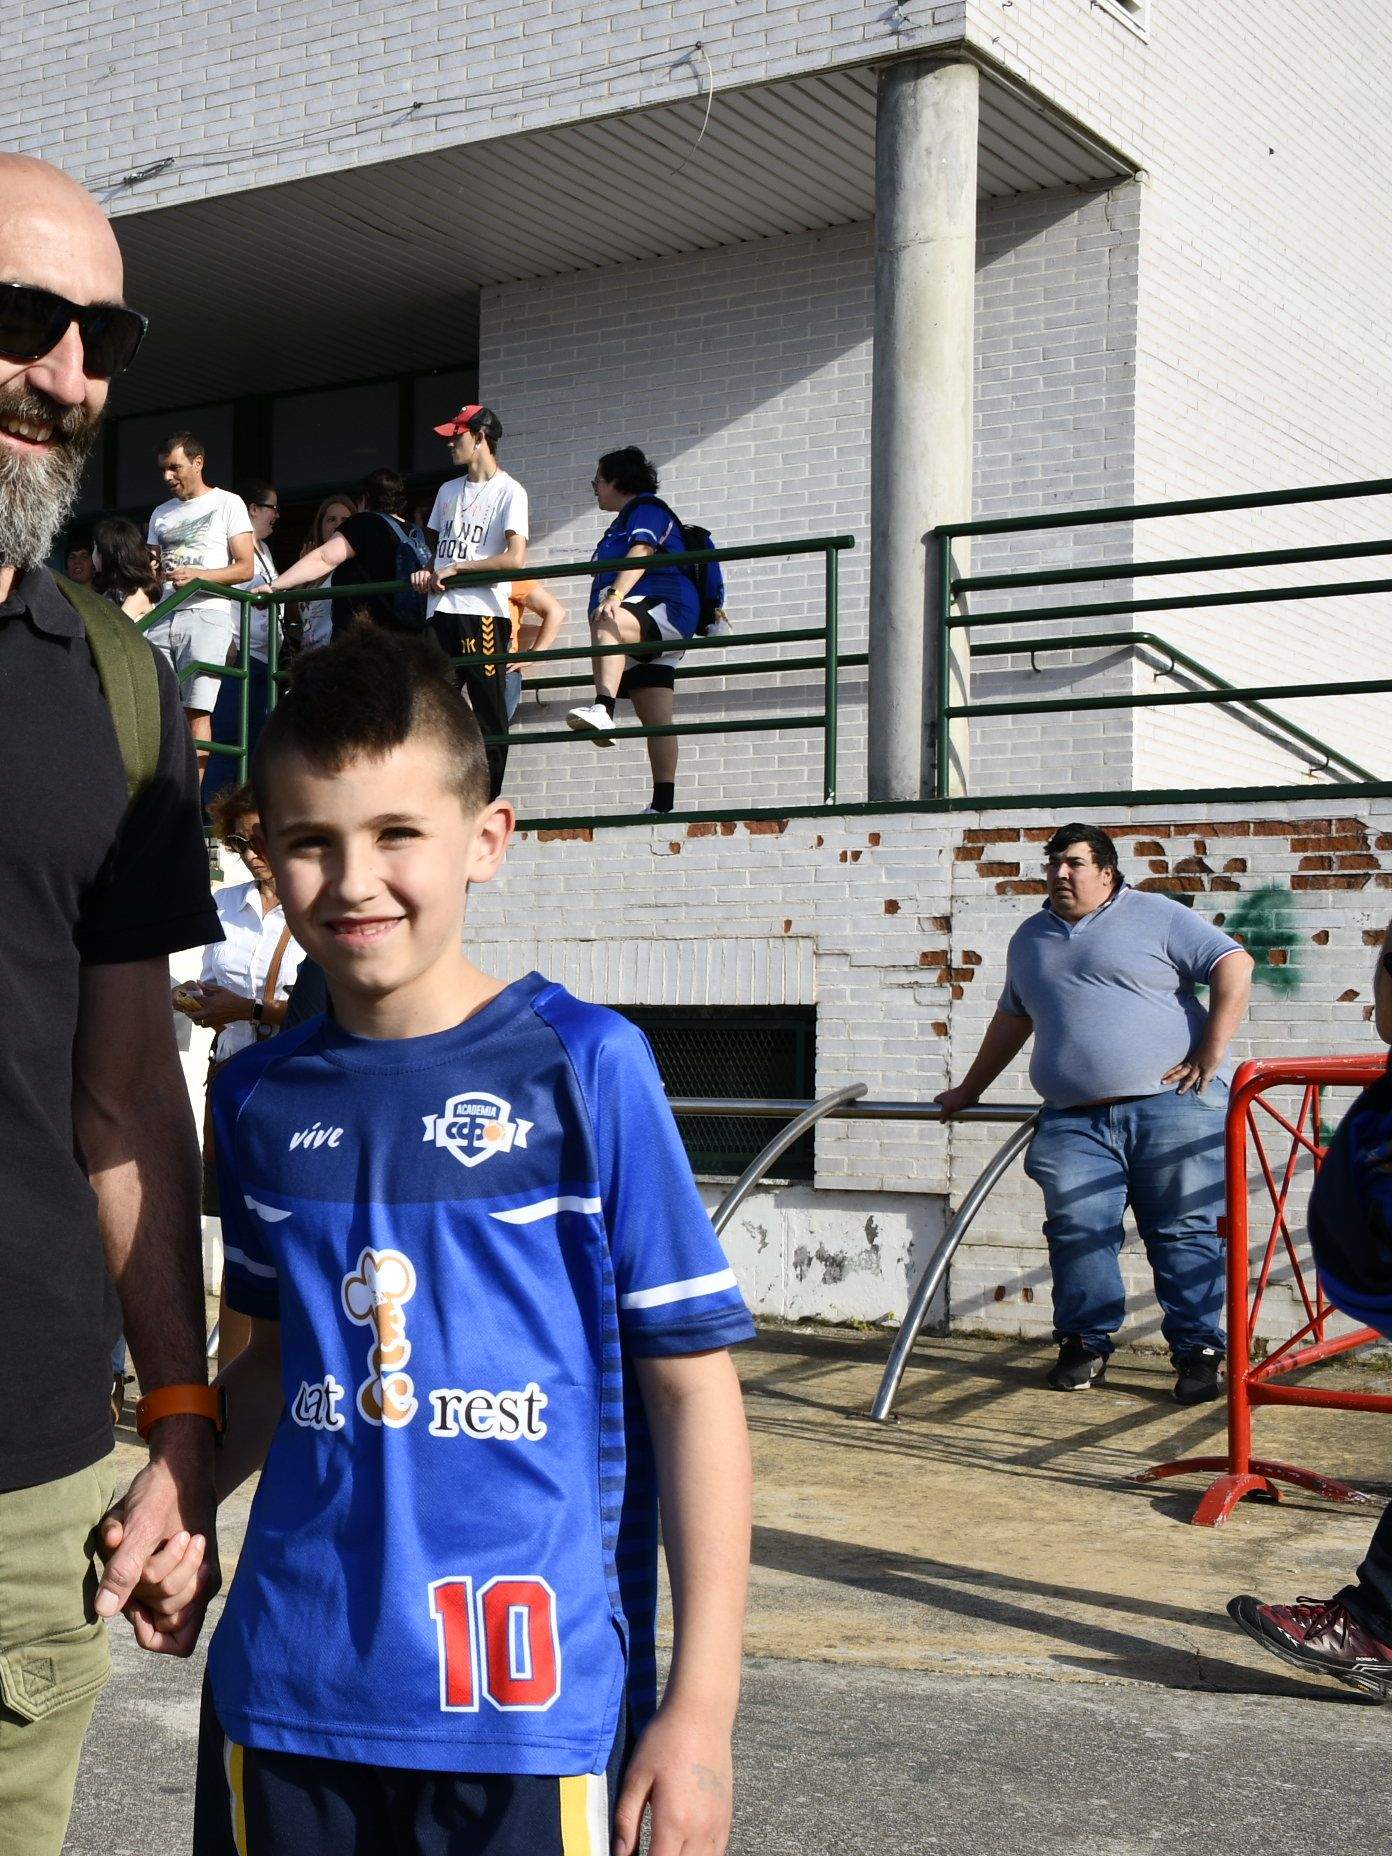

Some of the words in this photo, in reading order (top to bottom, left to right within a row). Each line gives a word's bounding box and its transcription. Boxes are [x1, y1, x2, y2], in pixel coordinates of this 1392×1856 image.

[456, 1103, 497, 1117] ACADEMIA
[434, 1388, 543, 1436] rest
[427, 1575, 562, 1713] 10
